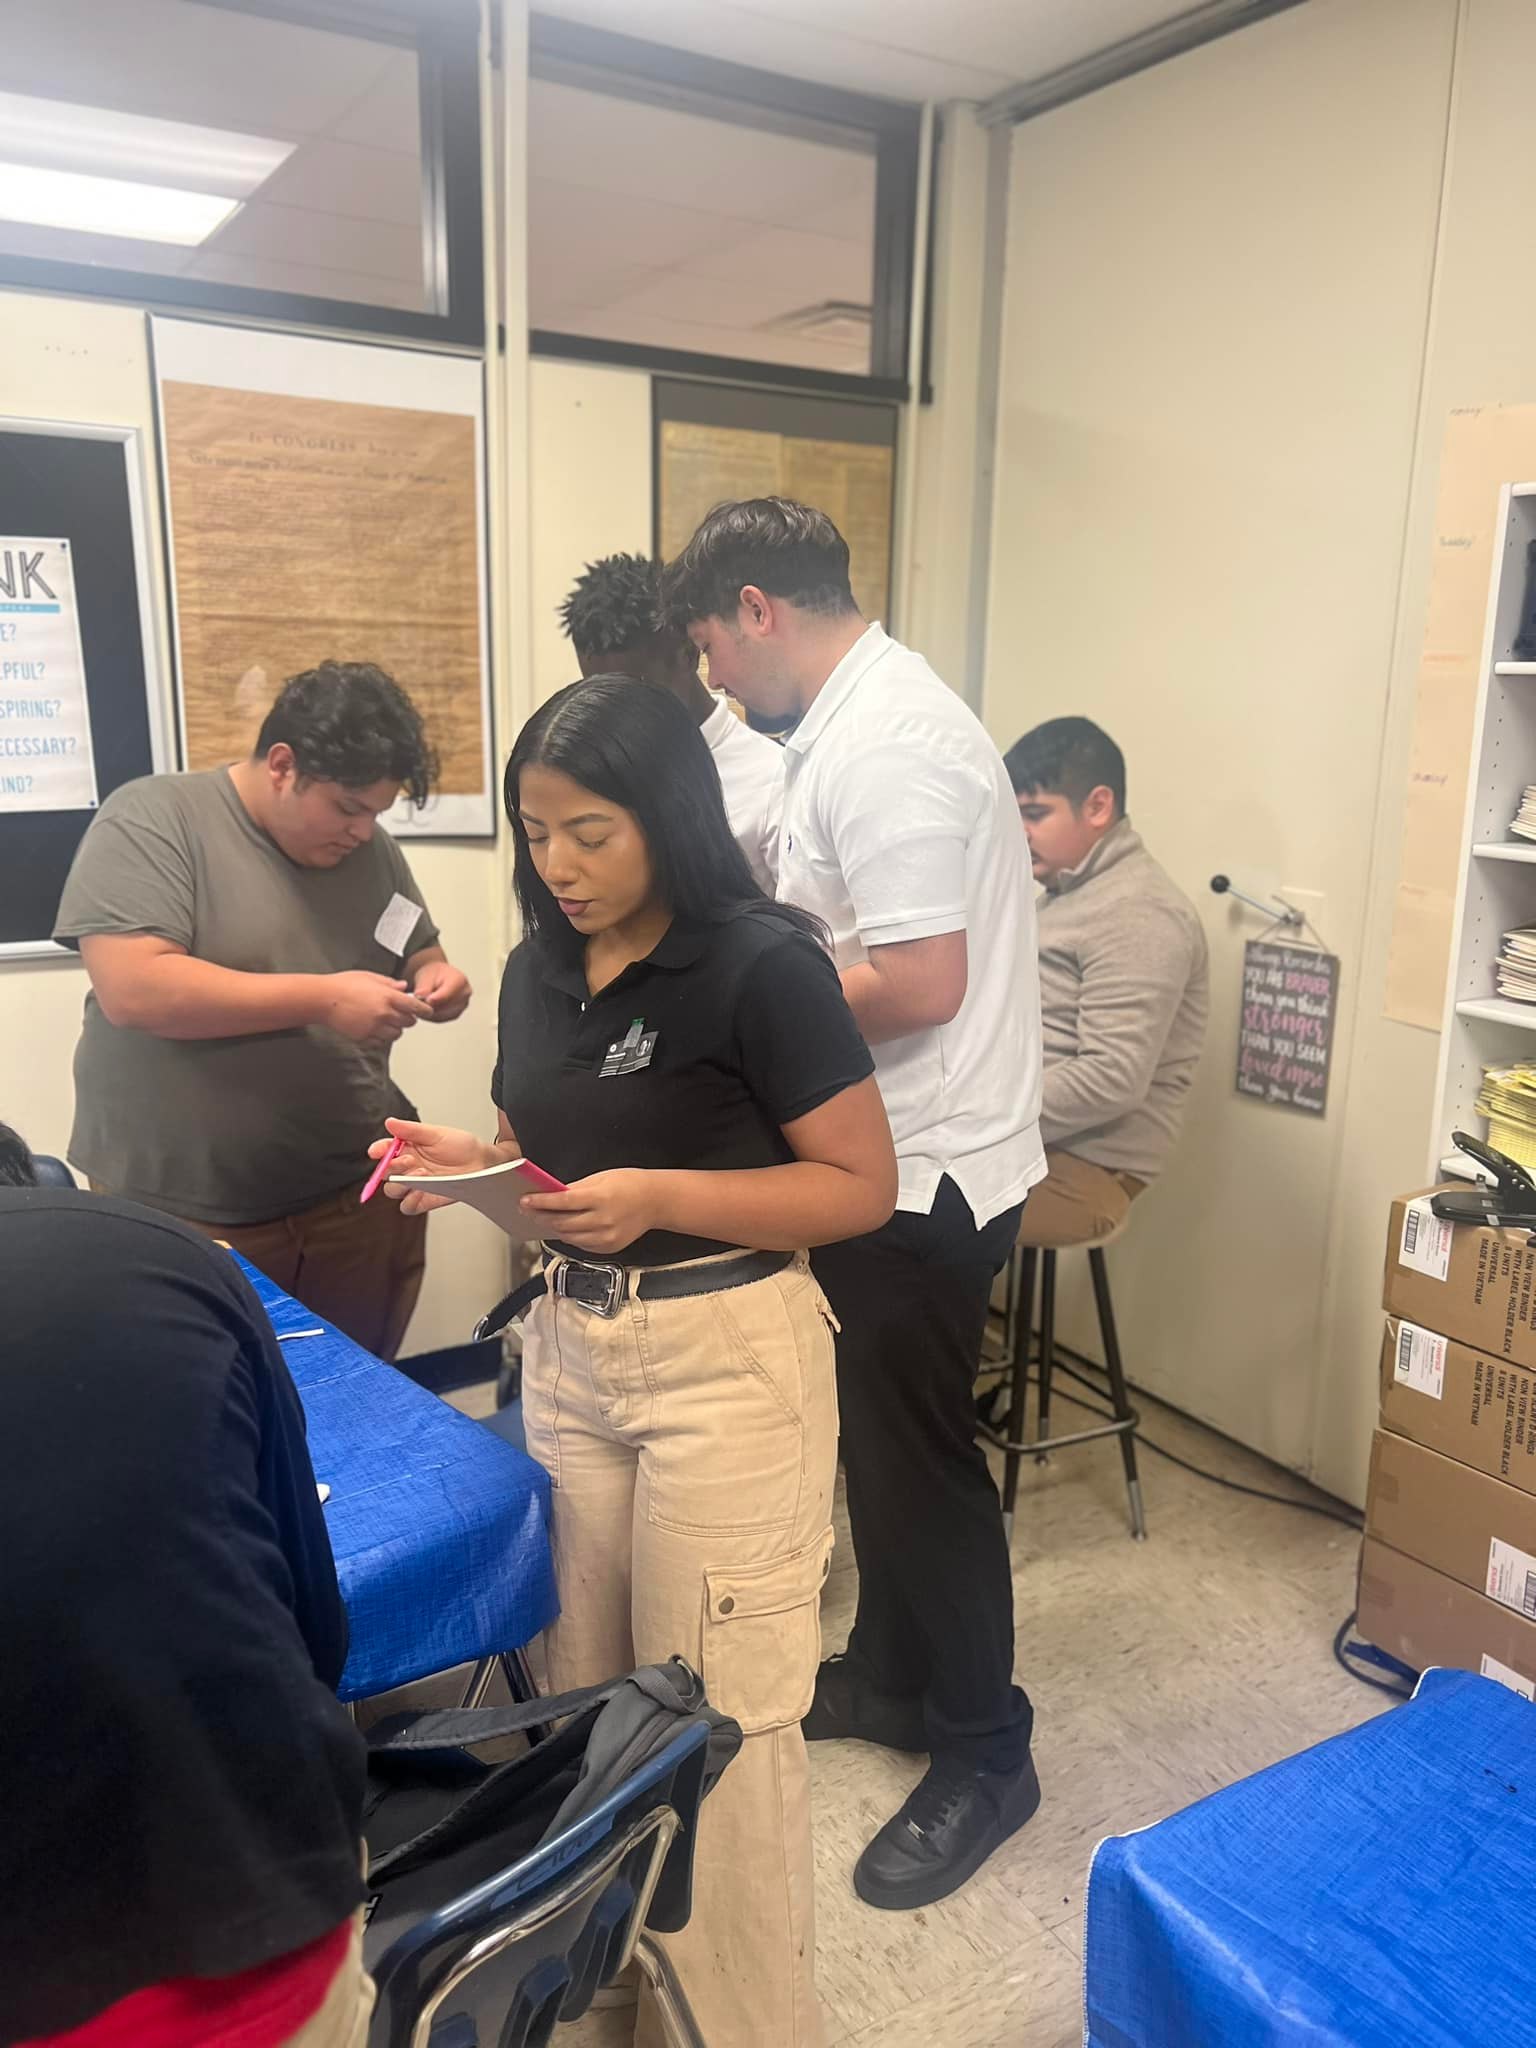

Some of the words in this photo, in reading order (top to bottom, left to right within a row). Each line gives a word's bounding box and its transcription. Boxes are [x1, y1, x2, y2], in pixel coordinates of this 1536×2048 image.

[0, 661, 46, 681] PFUL?
[1243, 1004, 1324, 1046] stronger
[1241, 1029, 1271, 1051] THAN
[1272, 1037, 1296, 1059] YOU
[1296, 1043, 1327, 1065] SEEM
[1480, 1238, 1489, 1260] MADE
[1514, 1249, 1523, 1273] WITH
[1479, 1260, 1486, 1271] IN
[1489, 1241, 1500, 1284] UNIVERSAL
[1502, 1252, 1511, 1276] UNITS
[1526, 1252, 1535, 1271] NON
[1475, 1271, 1485, 1305] VIETNAM
[1511, 1274, 1520, 1296] LABEL
[1524, 1271, 1532, 1292] VIEW
[1507, 1296, 1517, 1327] HOLDER
[1520, 1292, 1530, 1322] BINDER
[1504, 1327, 1513, 1354] BLACK
[1475, 1360, 1484, 1383] MADE
[1510, 1373, 1518, 1394] WITH
[1474, 1382, 1481, 1392] IN
[1484, 1365, 1495, 1406] UNIVERSAL
[1497, 1376, 1506, 1400] UNITS
[1520, 1377, 1529, 1396] NON
[1471, 1392, 1480, 1426] VIETNAM
[1507, 1394, 1516, 1418] LABEL
[1519, 1396, 1527, 1416] VIEW
[1504, 1419, 1513, 1450] HOLDER
[1516, 1416, 1525, 1446] BINDER
[1501, 1449, 1510, 1476] BLACK
